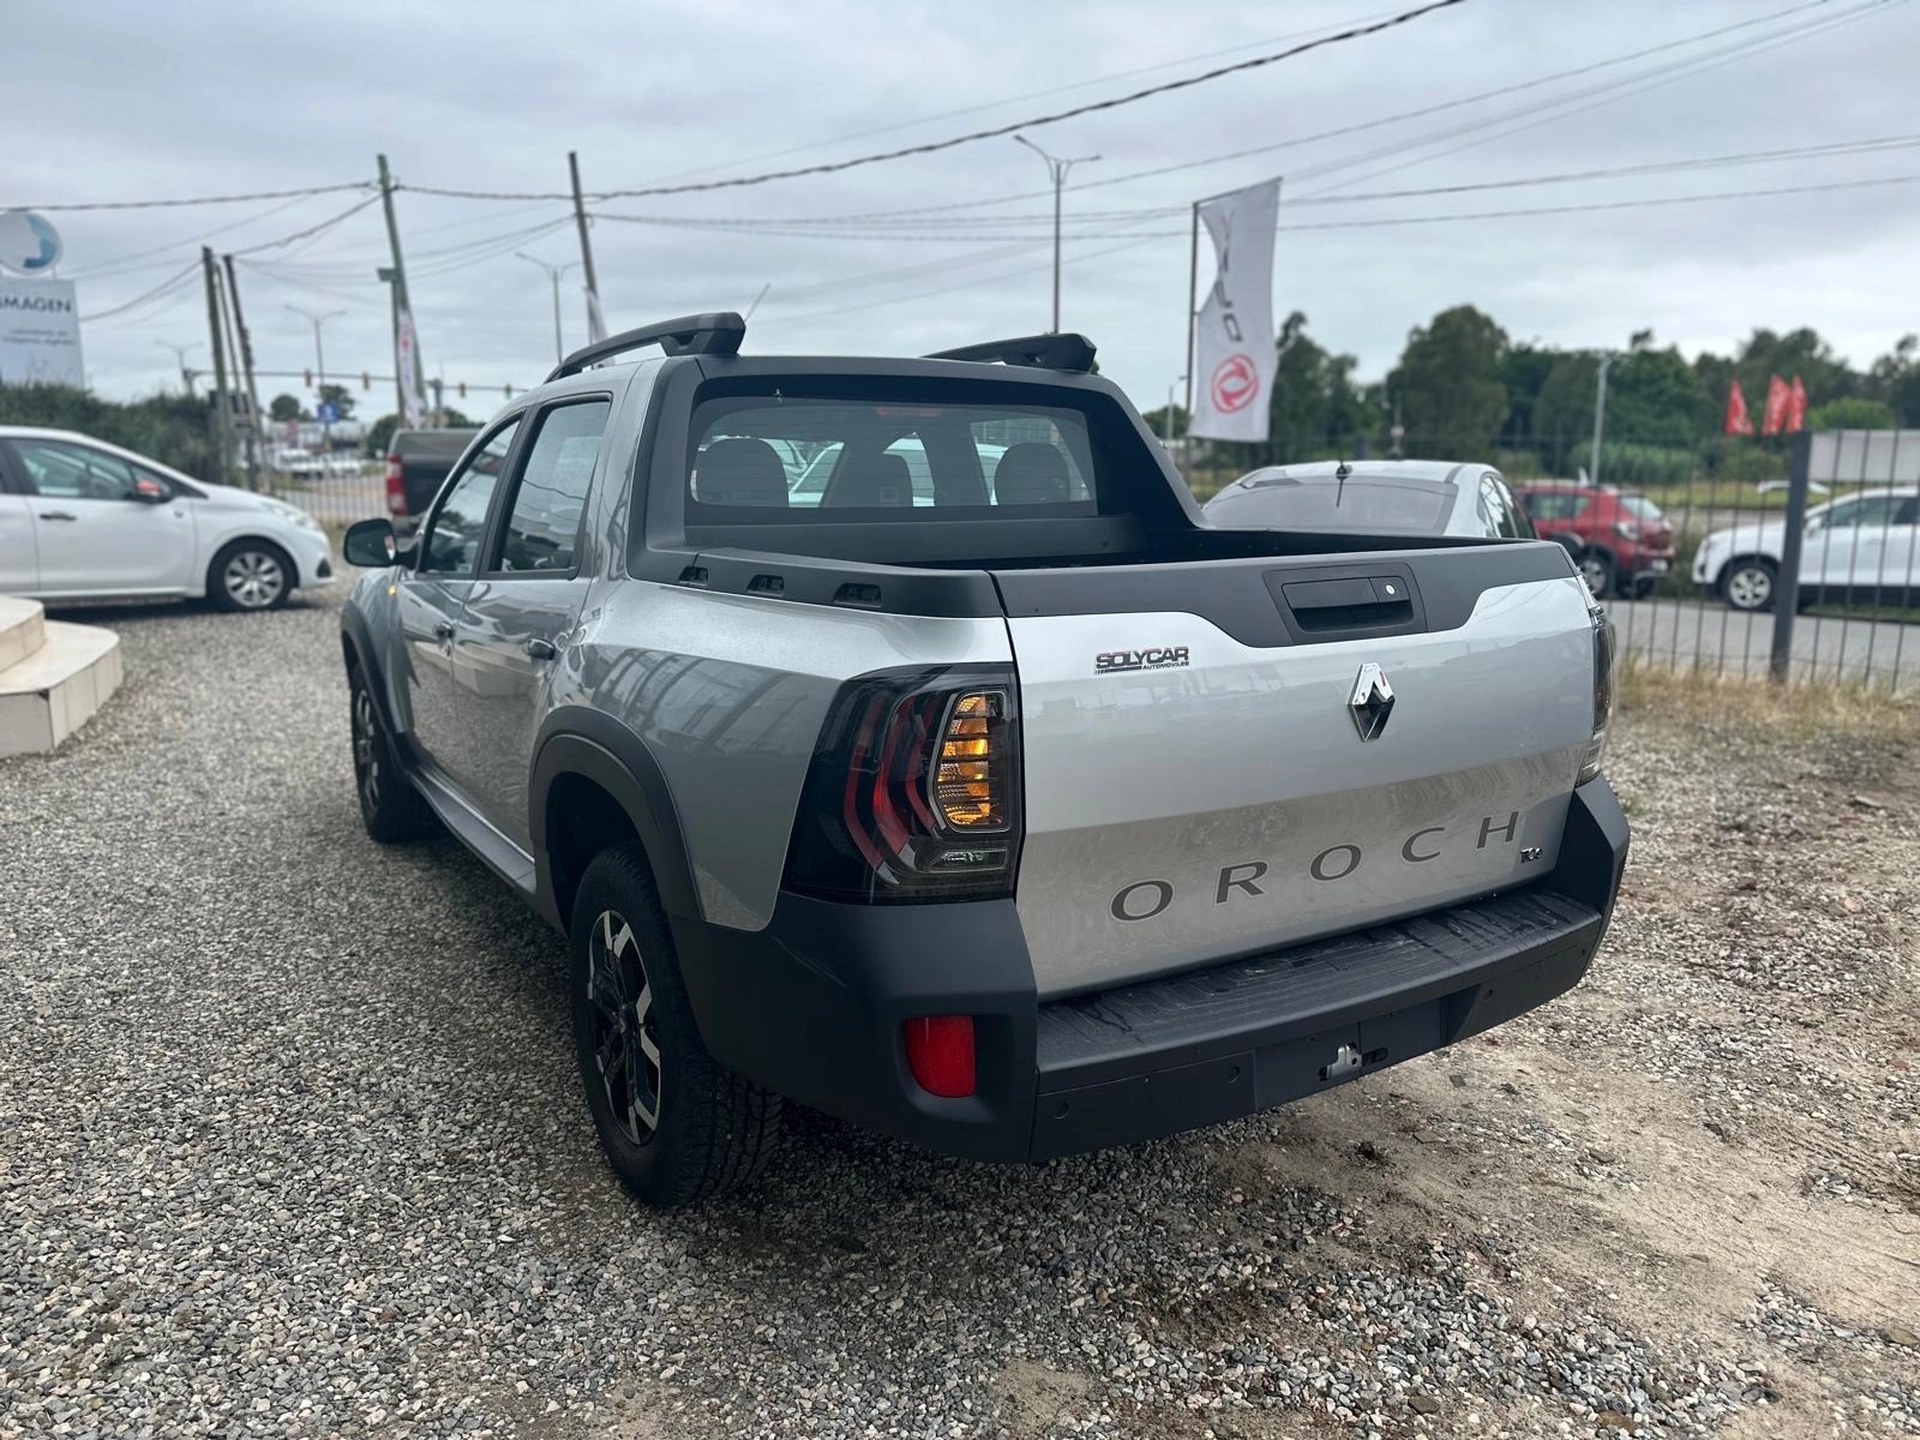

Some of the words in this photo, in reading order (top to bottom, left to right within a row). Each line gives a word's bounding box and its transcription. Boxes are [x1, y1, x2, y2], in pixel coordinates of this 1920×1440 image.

[1095, 647, 1190, 669] SOLYCAR
[1142, 661, 1190, 670] AUTOMOVILES
[1110, 810, 1520, 922] OROCH
